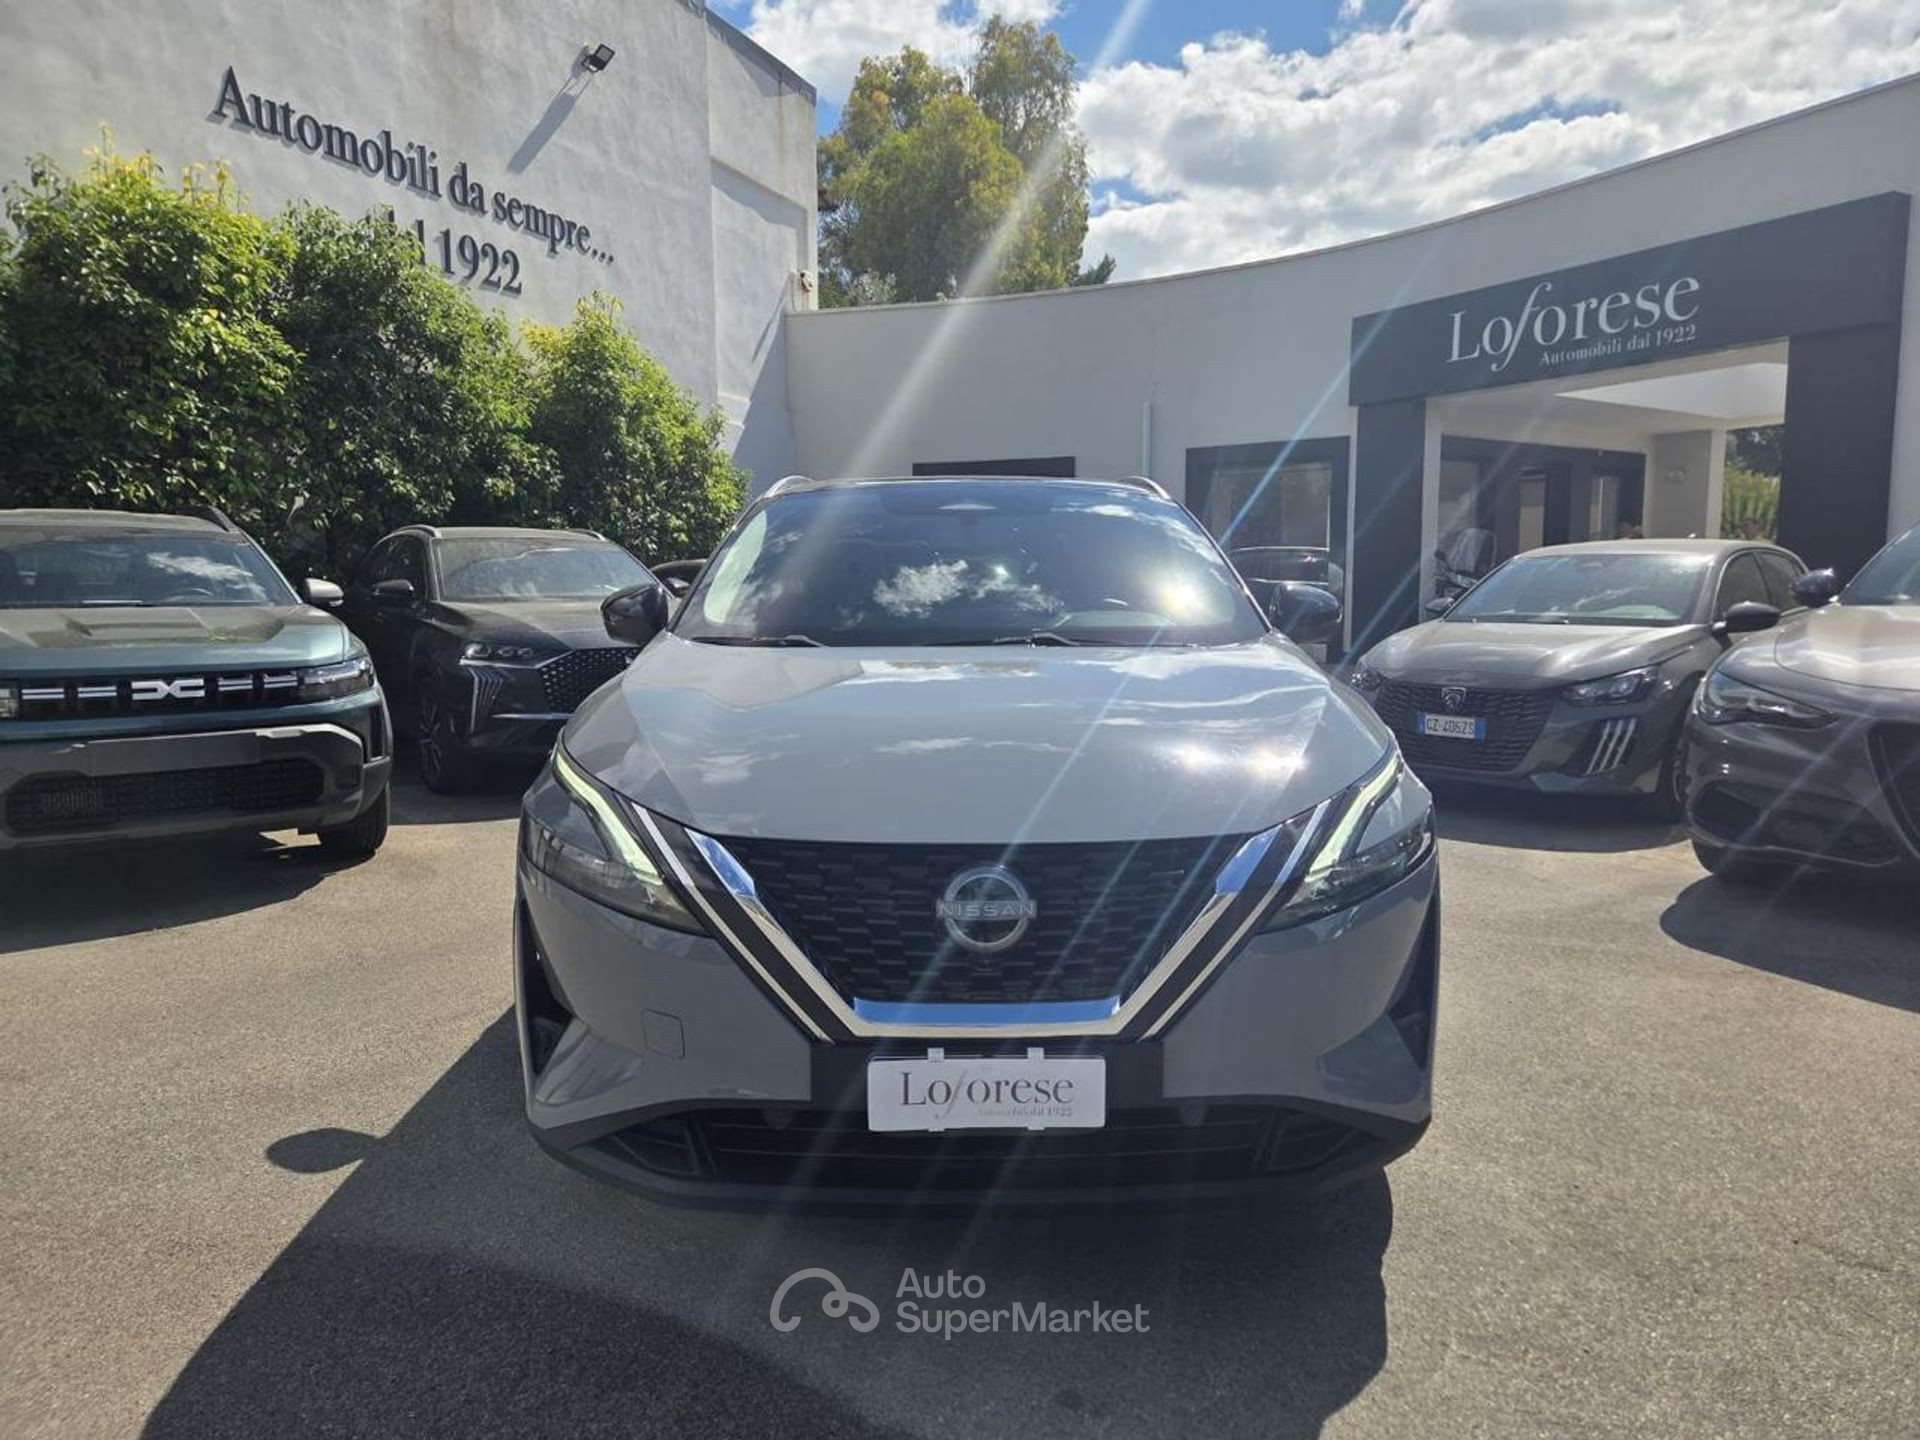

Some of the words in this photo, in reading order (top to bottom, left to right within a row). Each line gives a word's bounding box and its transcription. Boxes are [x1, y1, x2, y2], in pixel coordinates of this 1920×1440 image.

[212, 65, 442, 198] Automobili
[448, 161, 488, 215] da
[439, 227, 523, 295] 1922
[1446, 275, 1700, 372] Loforese
[1540, 336, 1622, 366] Automobili
[1627, 331, 1650, 350] dal
[1655, 323, 1696, 347] 1922
[939, 902, 1034, 917] NISSAN
